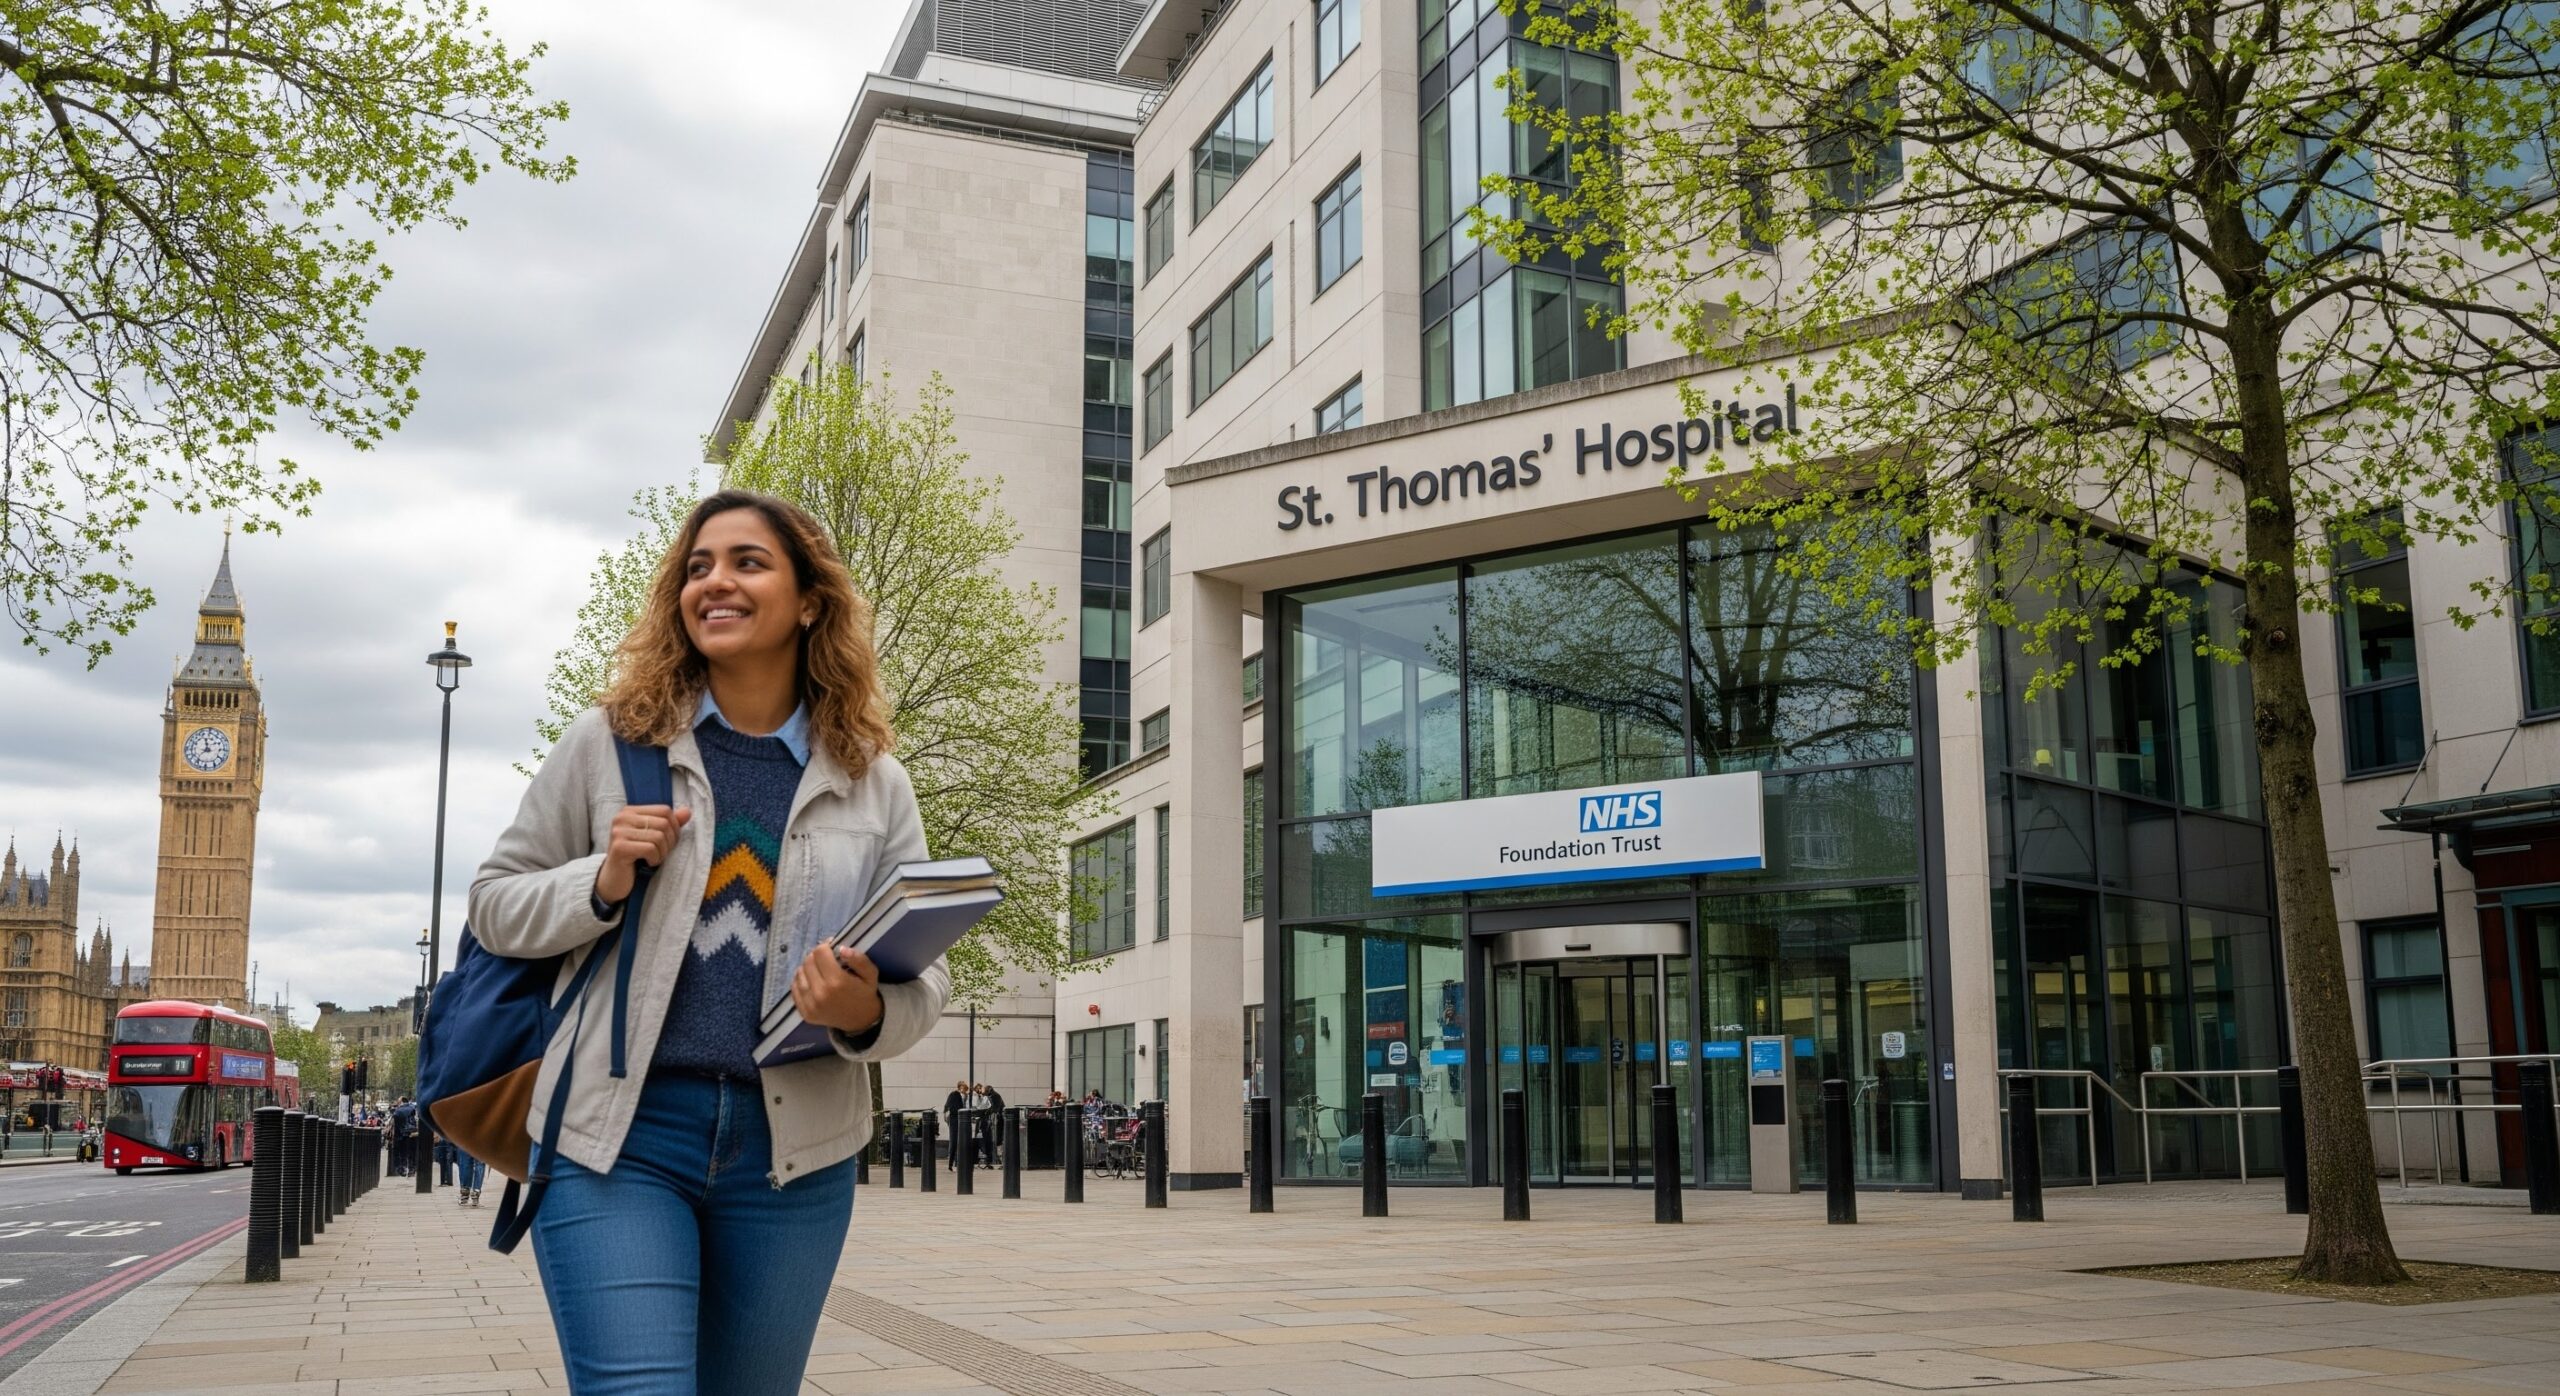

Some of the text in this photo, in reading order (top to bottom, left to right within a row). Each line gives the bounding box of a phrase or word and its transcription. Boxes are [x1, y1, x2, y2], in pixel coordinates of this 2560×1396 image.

[1277, 382, 1800, 531] St. Thomas' Hospital
[1582, 792, 1660, 831] NHS
[1500, 834, 1662, 864] Foundation Trust
